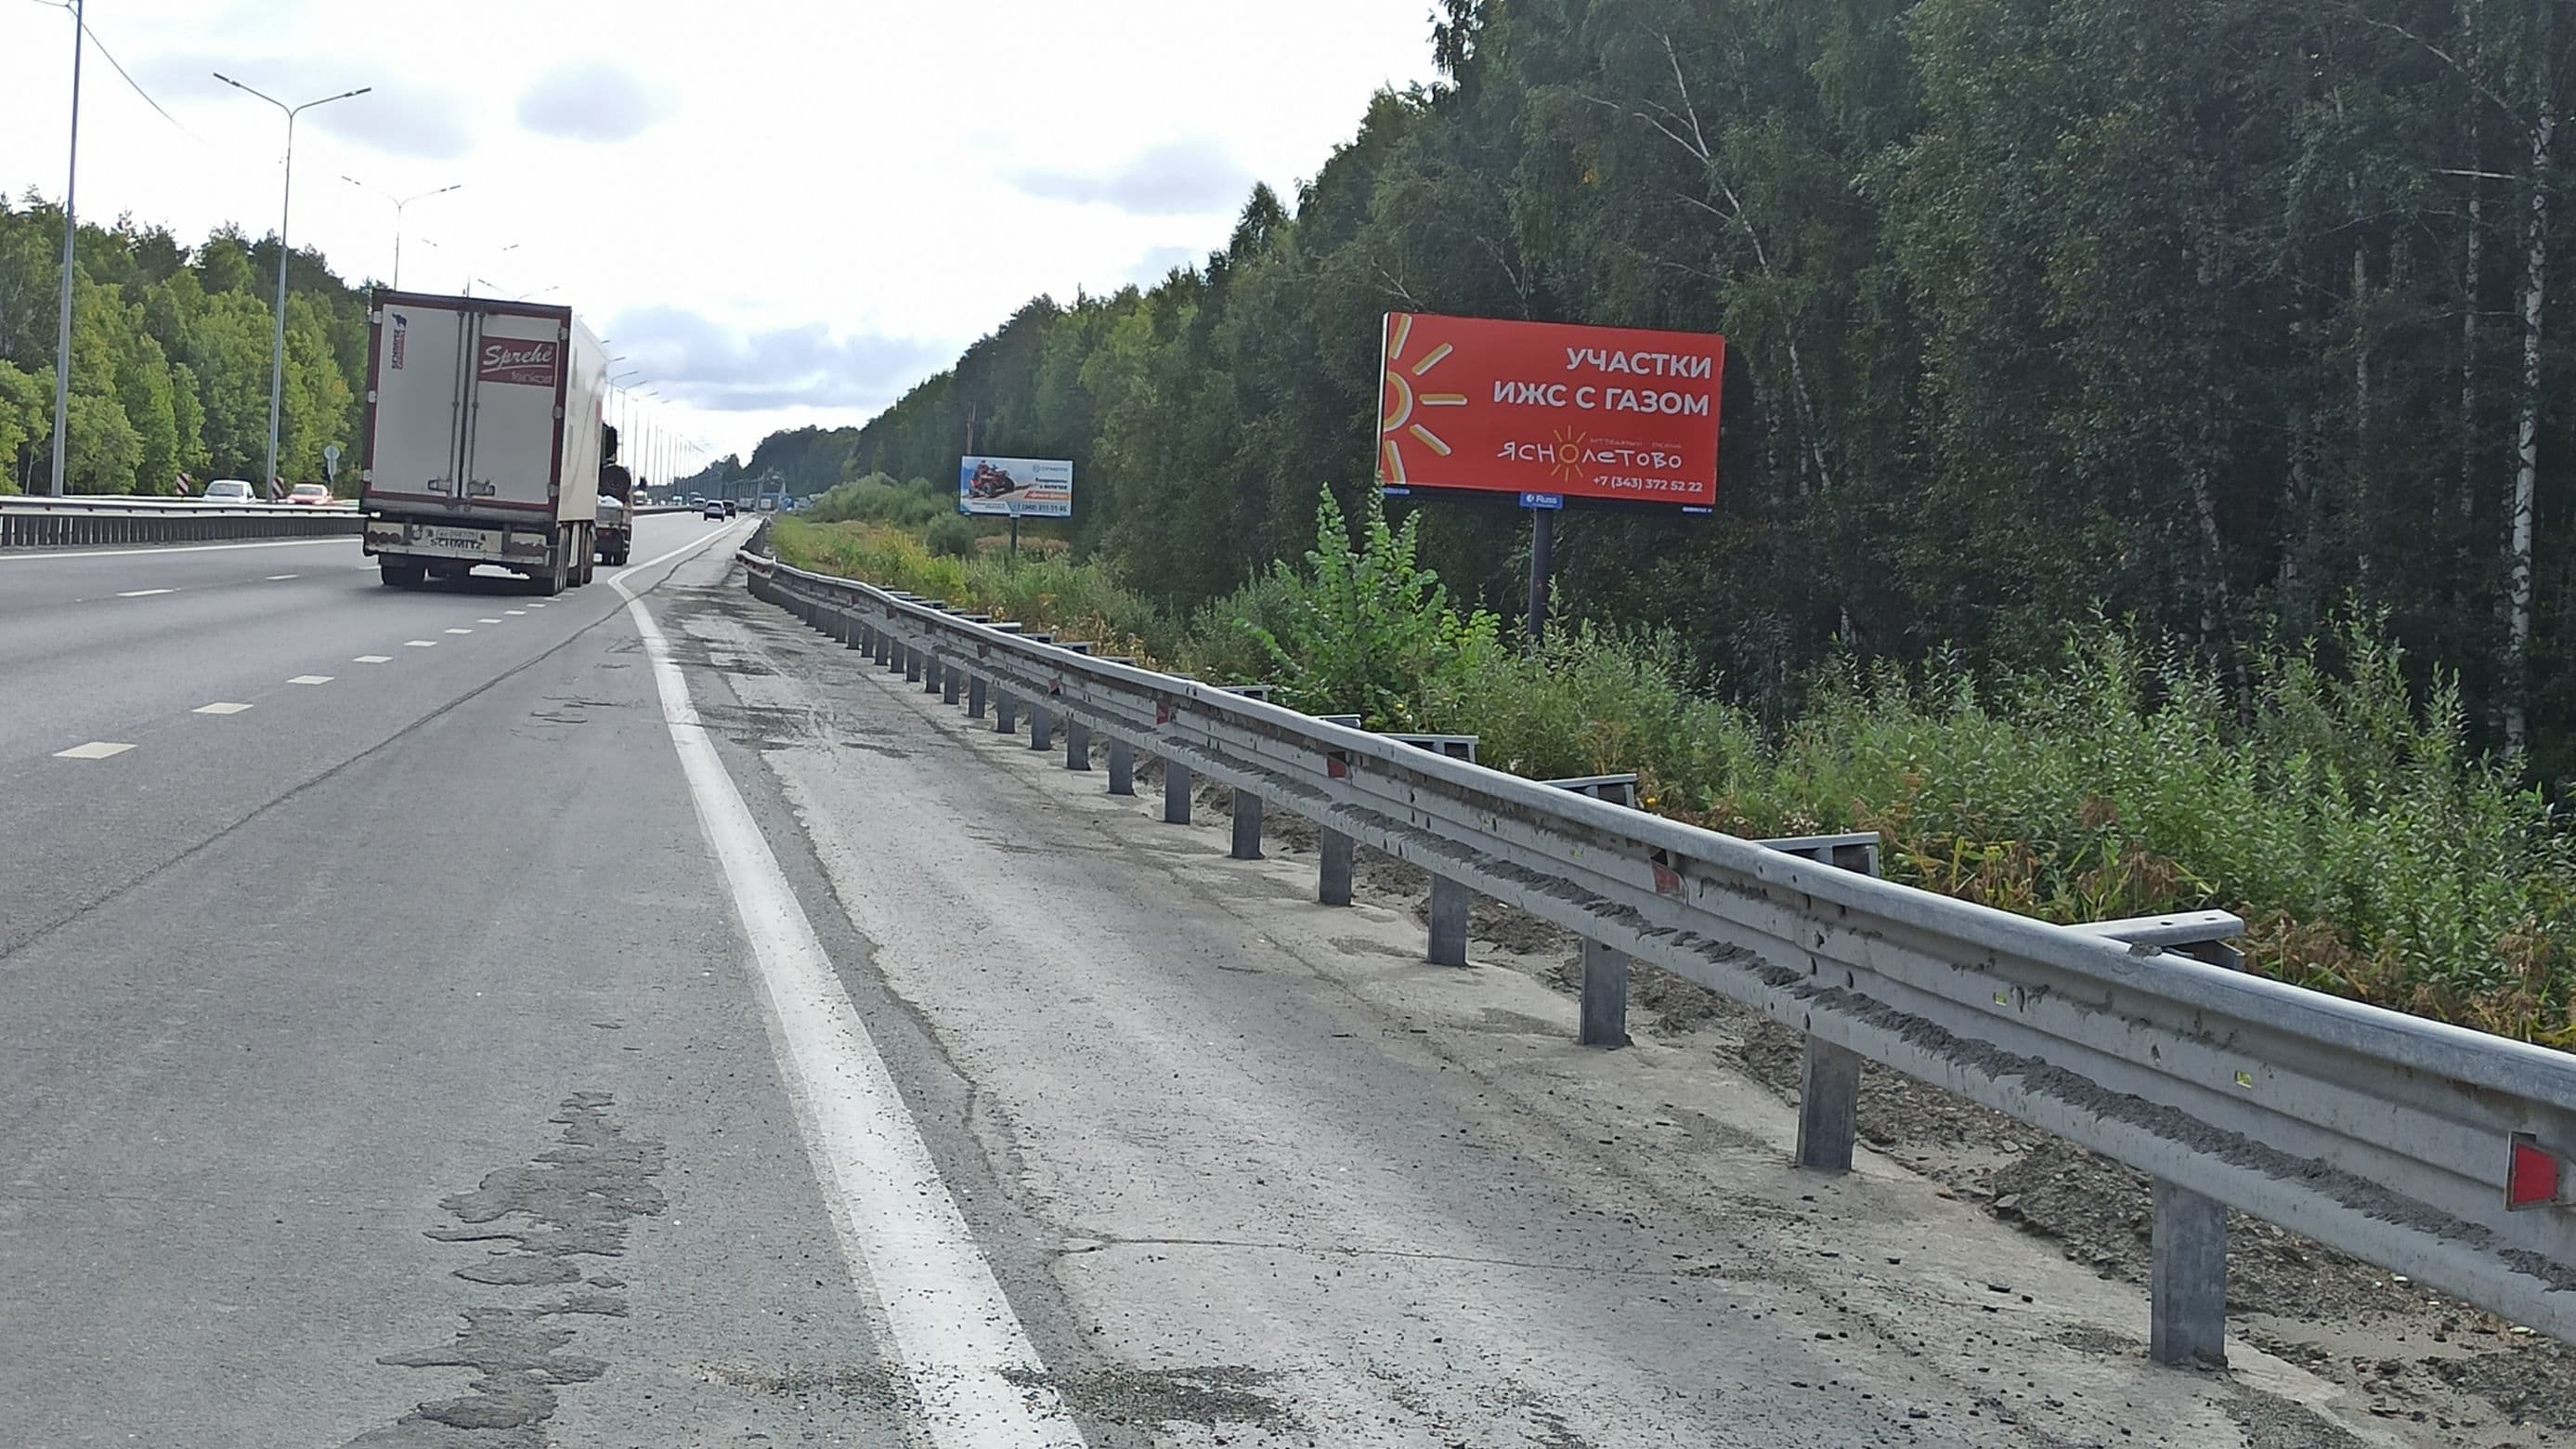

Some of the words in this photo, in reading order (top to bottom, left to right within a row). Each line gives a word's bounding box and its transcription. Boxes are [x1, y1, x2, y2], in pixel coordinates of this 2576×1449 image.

[1567, 347, 1711, 379] УЧАСТКИ
[1493, 381, 1568, 407] ИЖС
[1575, 386, 1596, 409] С
[1605, 387, 1709, 416] ГАЗОМ
[1594, 476, 1607, 486] +7
[1611, 476, 1643, 490] (343)
[1646, 478, 1668, 490] 372
[1671, 480, 1685, 491] 52
[1688, 482, 1703, 492] 22
